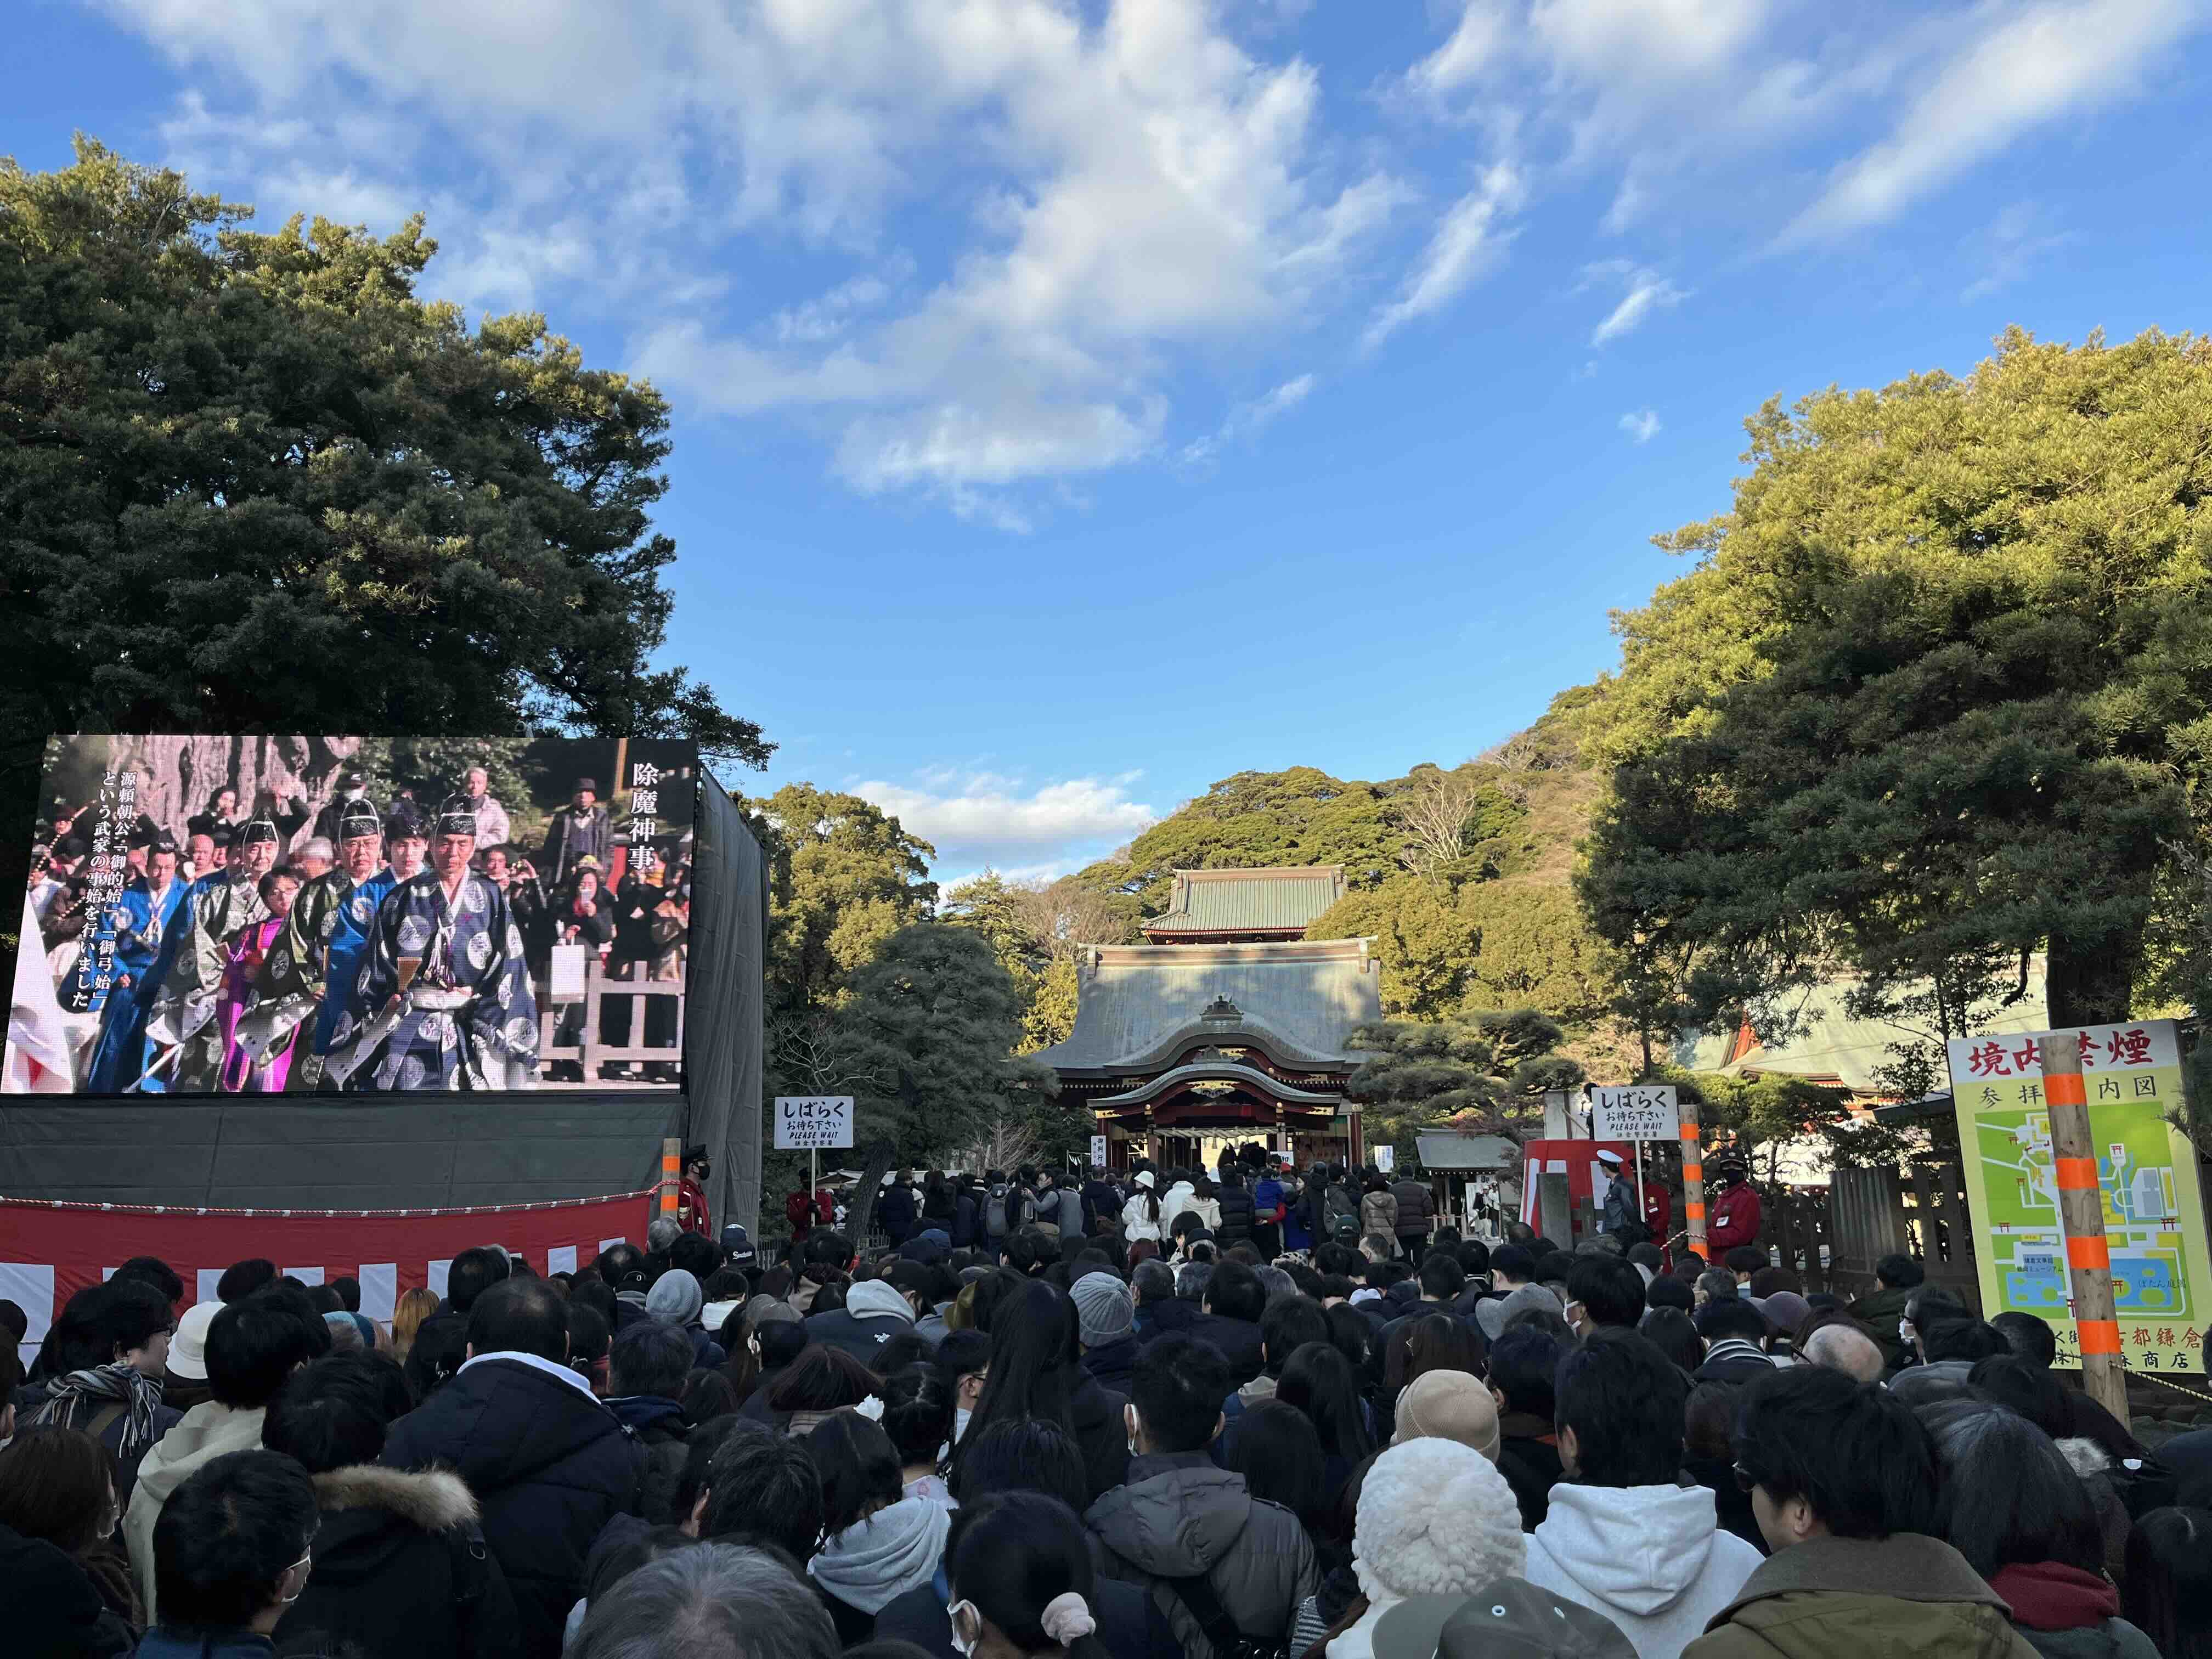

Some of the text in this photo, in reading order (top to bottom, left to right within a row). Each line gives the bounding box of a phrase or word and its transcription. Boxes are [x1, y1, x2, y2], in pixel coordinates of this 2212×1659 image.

[628, 763, 659, 870] 除魔神事
[72, 771, 115, 1007] という武家の事始を行いました
[1601, 1091, 1667, 1109] しばらく
[1980, 1075, 2157, 1109] 参拝内図
[784, 1101, 845, 1118] しばらく
[1606, 1111, 1665, 1122] お待ち下さい
[787, 1120, 841, 1131] お待ち下さい
